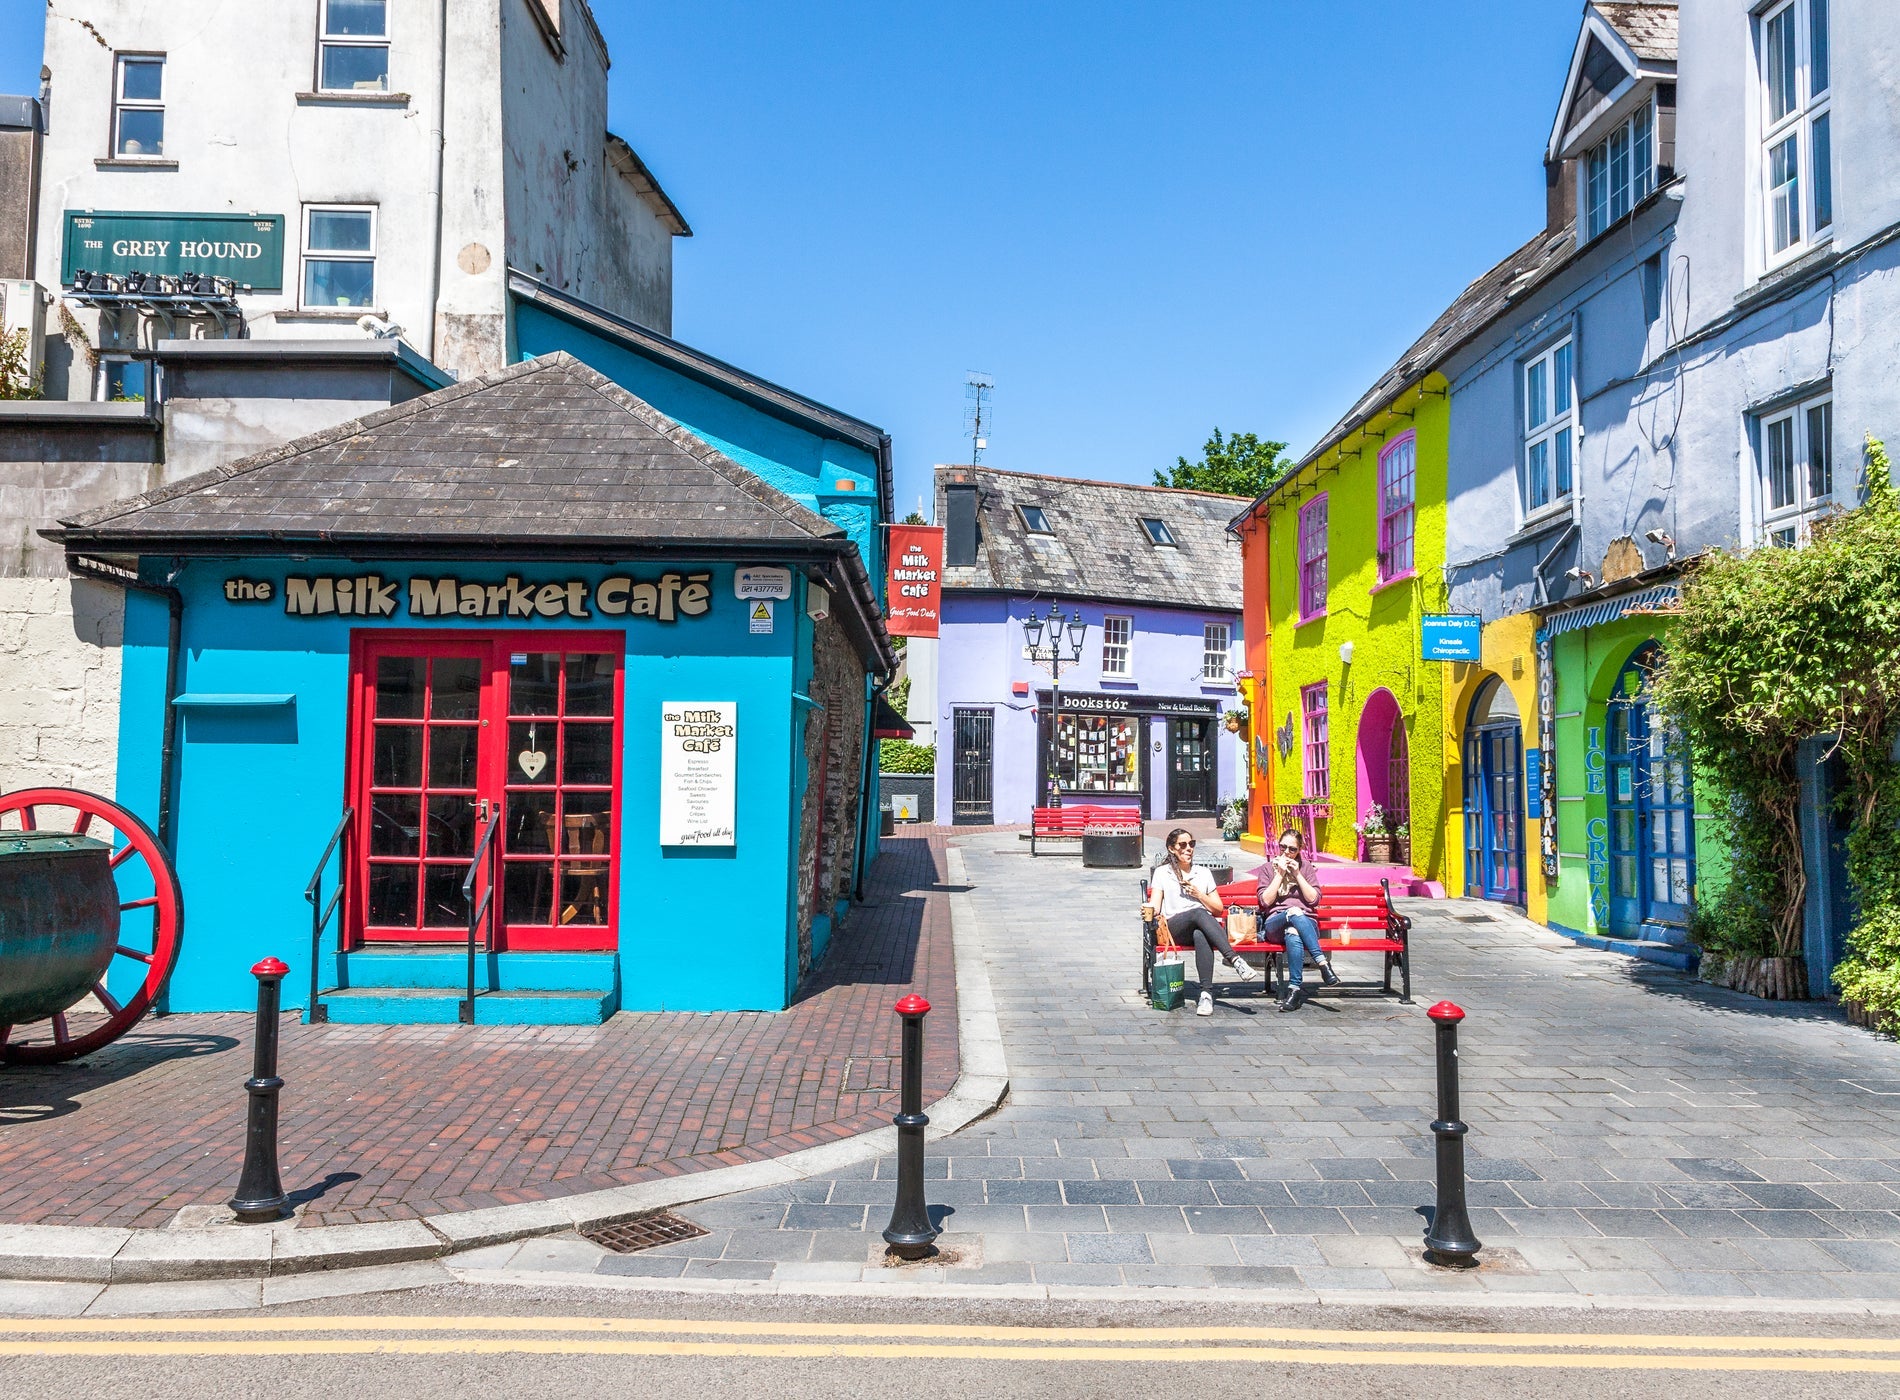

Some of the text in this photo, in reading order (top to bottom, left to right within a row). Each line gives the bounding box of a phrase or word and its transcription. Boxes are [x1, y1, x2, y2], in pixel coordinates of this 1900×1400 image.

[84, 239, 262, 259] THE GREY HOUND
[909, 545, 922, 553] the
[902, 554, 929, 567] Milk
[893, 569, 937, 582] Market
[224, 574, 711, 621] the Milk Market Café
[901, 583, 929, 598] Café
[889, 606, 936, 620] Great Food Daily
[1448, 620, 1463, 629] Daly
[1432, 647, 1471, 656] Chiropractic
[1063, 696, 1129, 710] bookstór
[1158, 702, 1172, 710] New
[1179, 703, 1193, 711] Used
[1193, 704, 1211, 712] Books
[664, 709, 722, 724] the Milk
[1540, 641, 1551, 789] SMOOTHIE
[674, 724, 734, 738] Market
[682, 738, 721, 754] Café
[1585, 727, 1605, 795] ICE
[713, 828, 721, 837] all
[1543, 798, 1554, 856] BAR
[1586, 817, 1610, 928] CREAM
